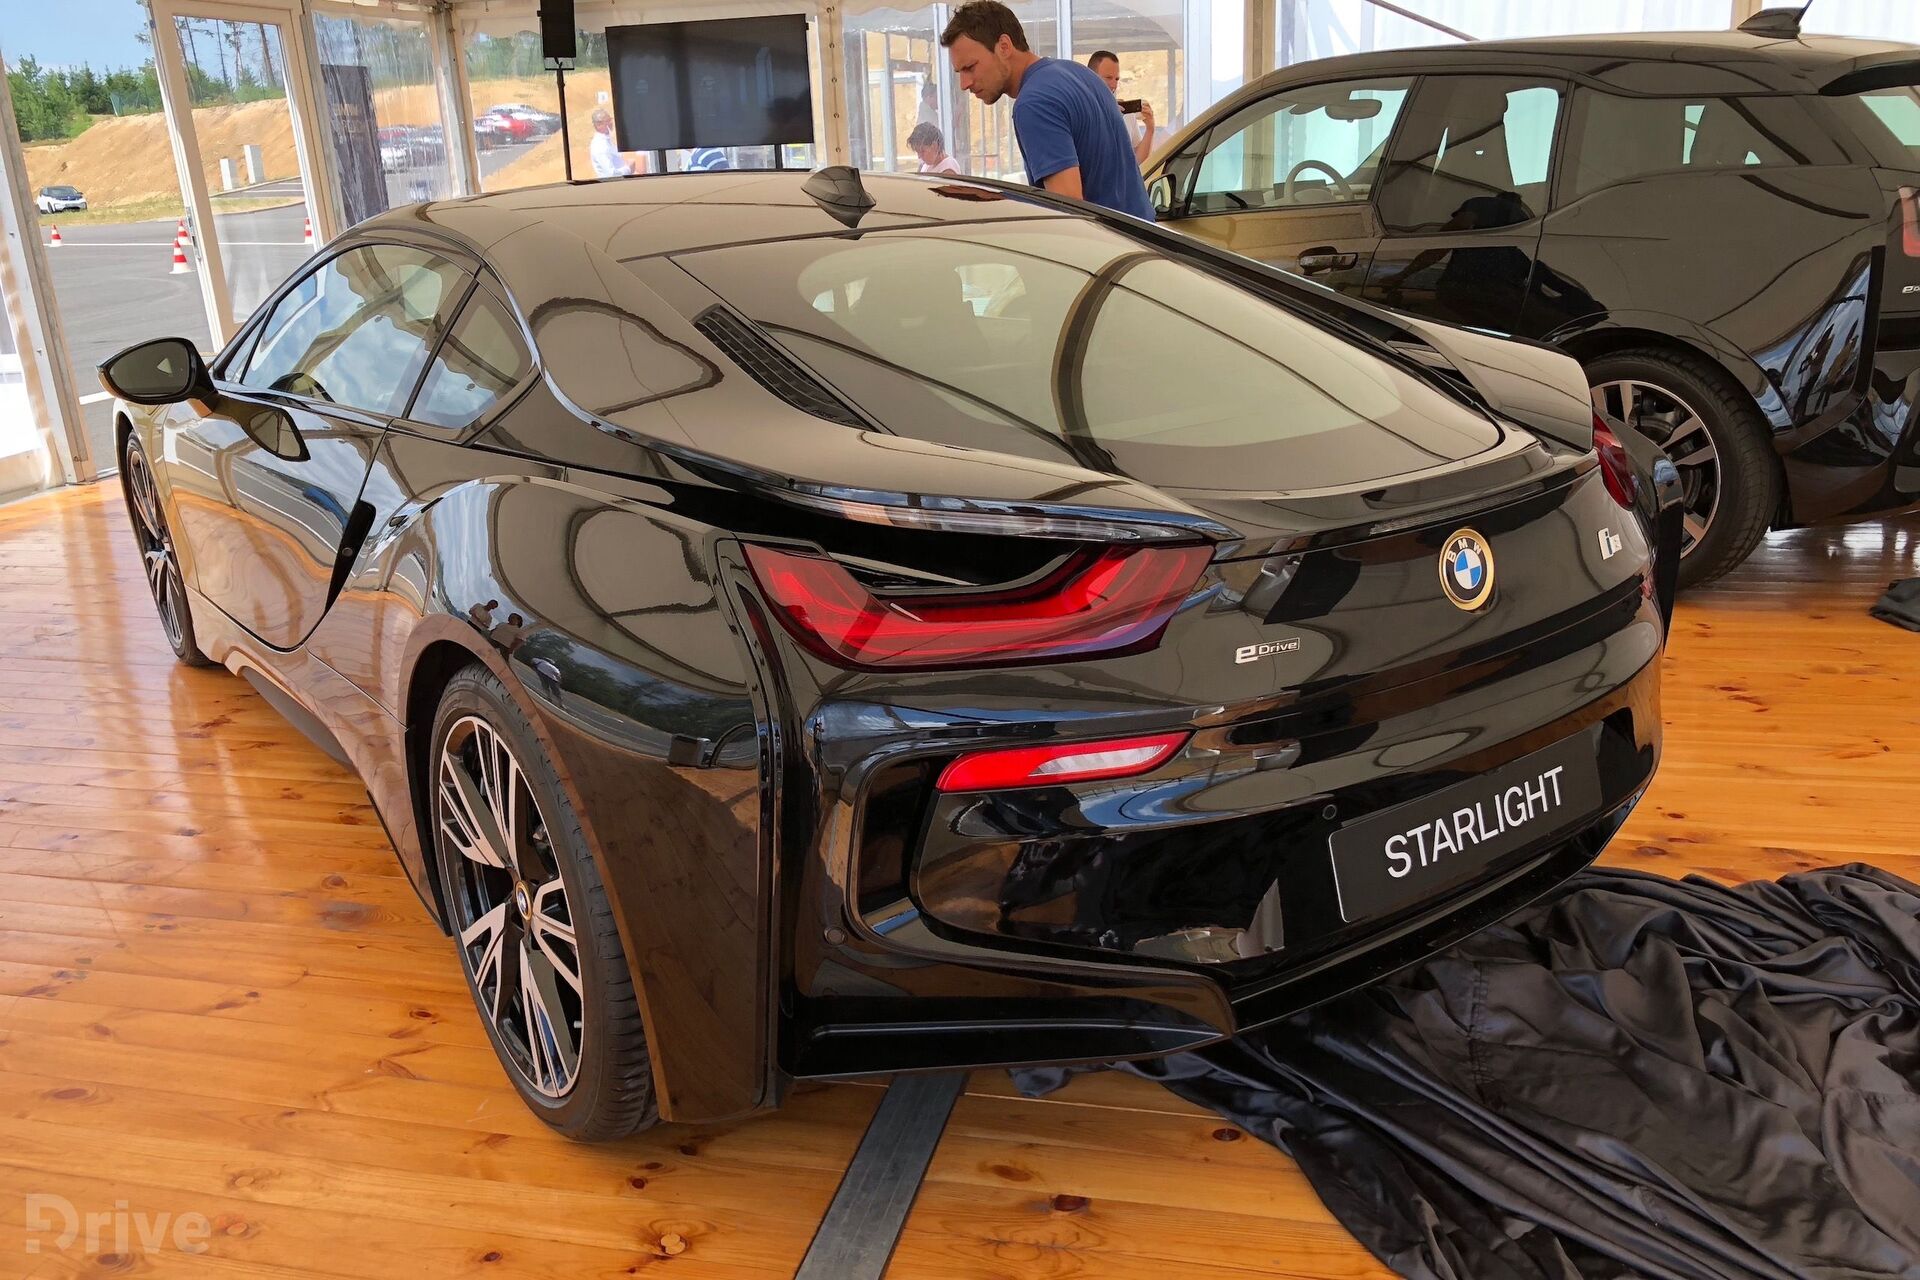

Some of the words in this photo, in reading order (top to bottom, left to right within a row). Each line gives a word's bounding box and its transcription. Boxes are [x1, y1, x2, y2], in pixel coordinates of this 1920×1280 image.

[1447, 538, 1482, 563] BMW
[1235, 641, 1298, 664] eDrive
[1384, 765, 1563, 878] STARLIGHT
